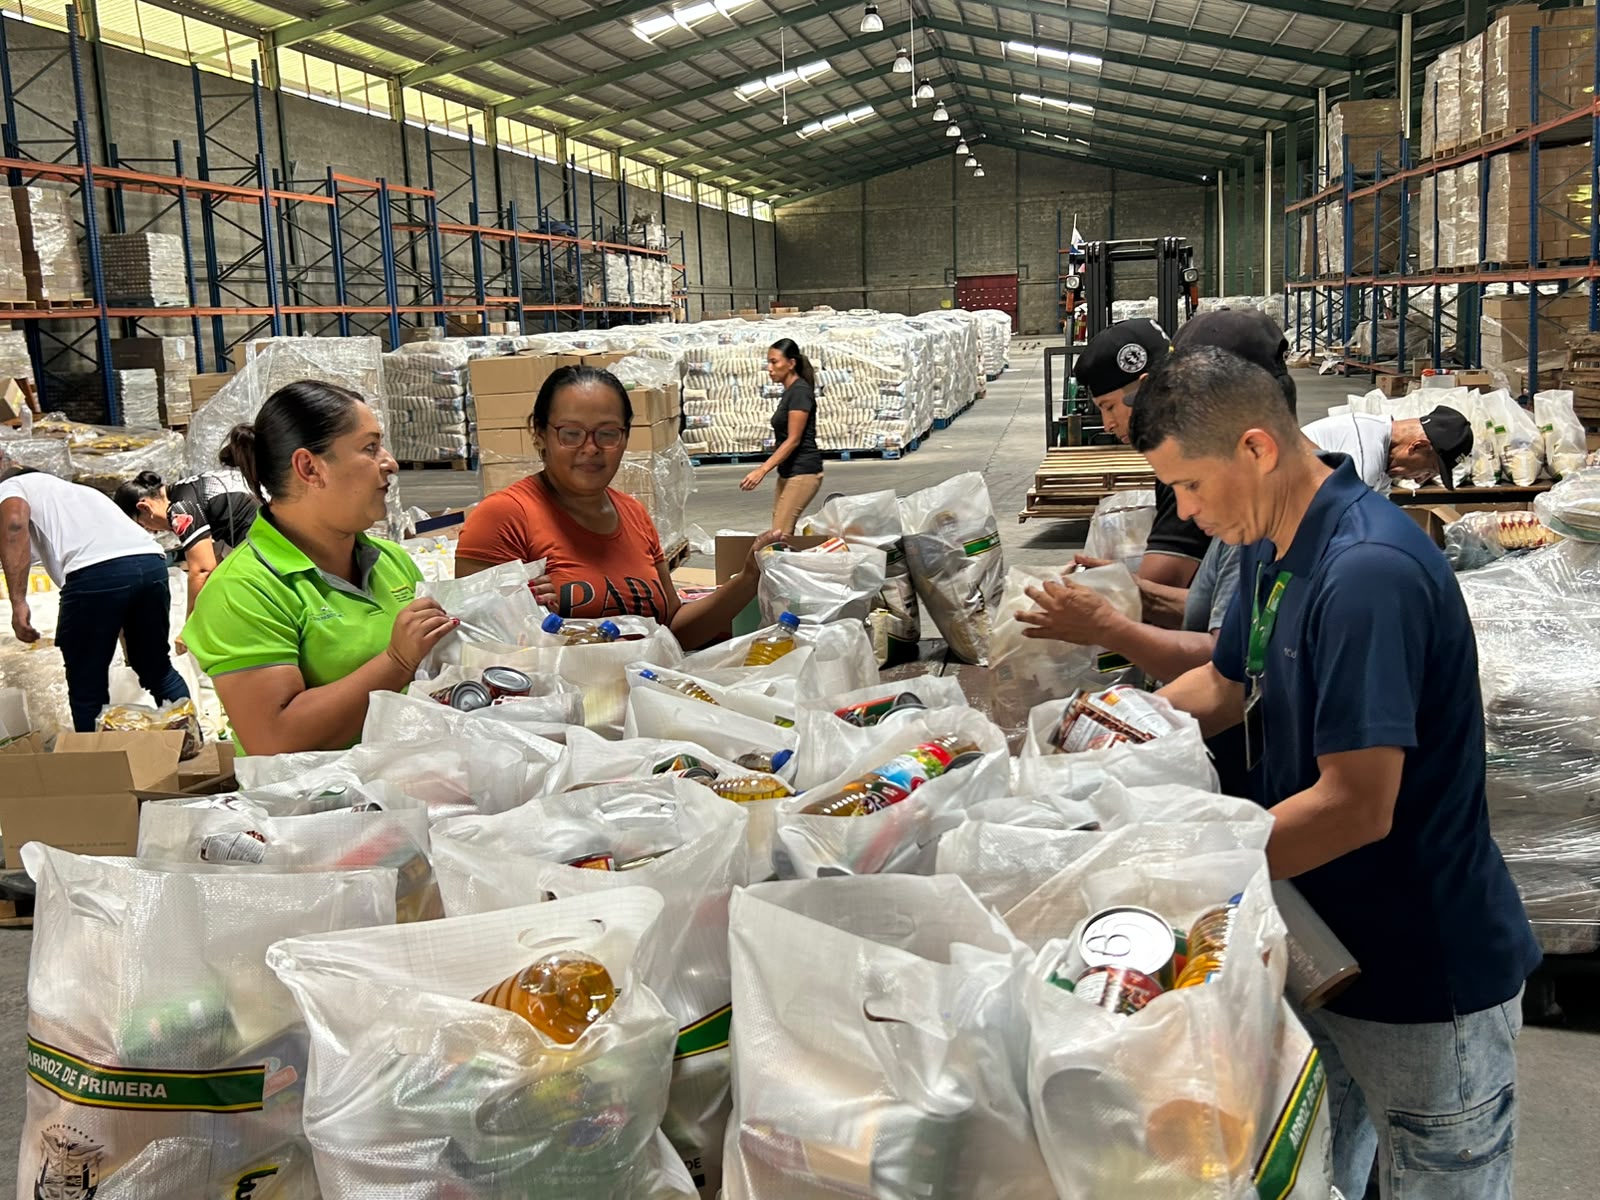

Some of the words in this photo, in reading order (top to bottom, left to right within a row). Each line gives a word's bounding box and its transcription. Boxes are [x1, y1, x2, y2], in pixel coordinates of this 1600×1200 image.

[28, 1050, 63, 1078] ARROZ
[61, 1066, 79, 1087] DE
[79, 1075, 168, 1098] PRIMERA
[1289, 1099, 1311, 1151] ARROZ
[1305, 1082, 1318, 1106] DE
